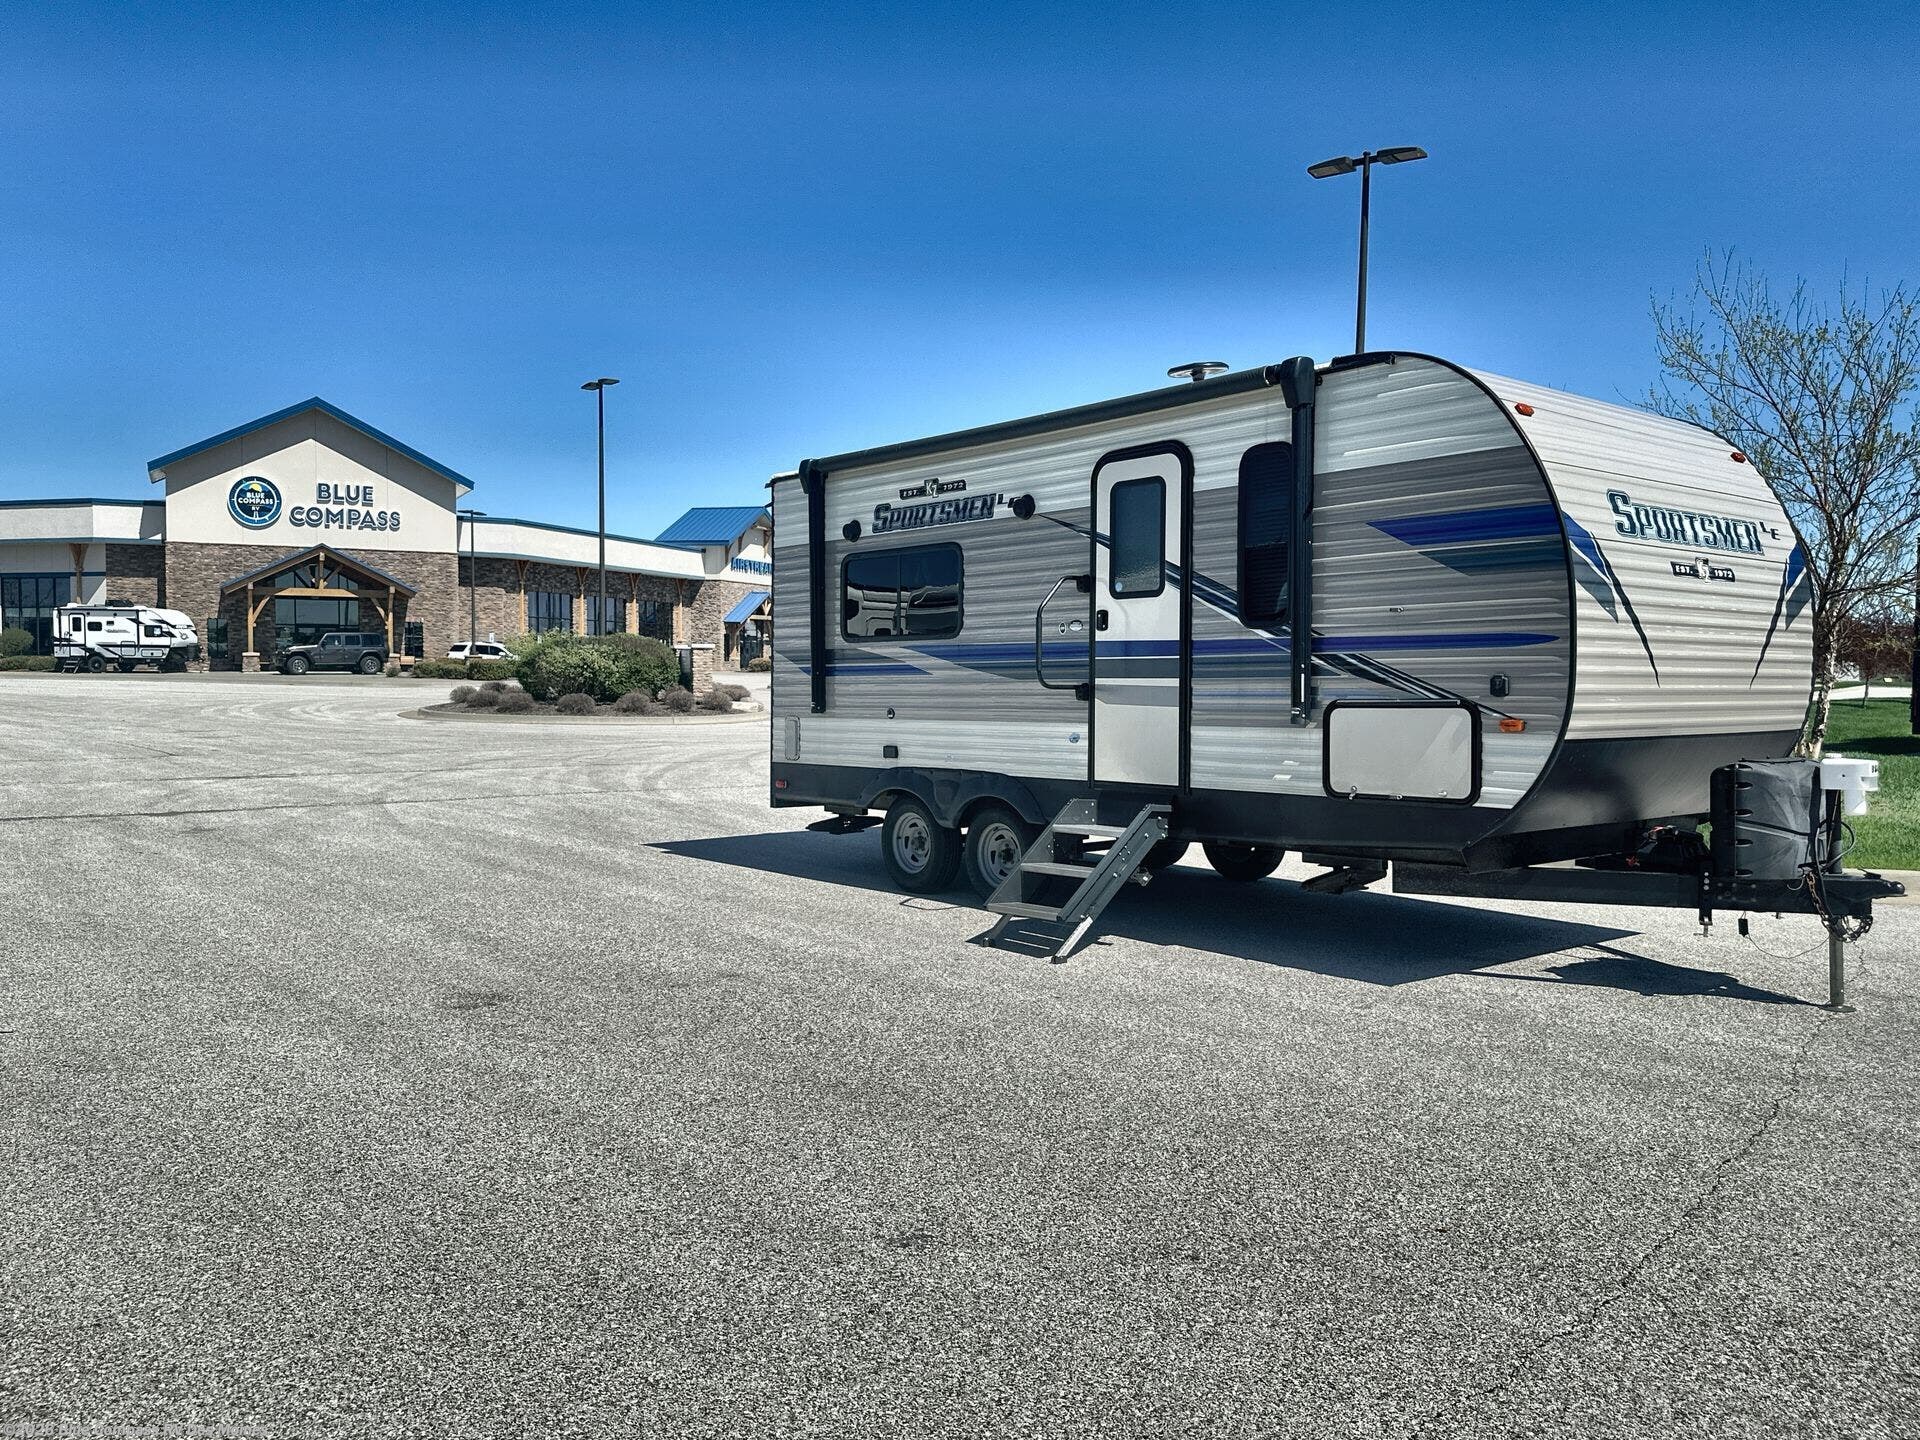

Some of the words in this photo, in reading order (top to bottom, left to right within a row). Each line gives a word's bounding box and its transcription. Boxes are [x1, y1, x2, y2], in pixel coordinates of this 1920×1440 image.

[246, 491, 265, 499] BLUE
[316, 482, 374, 507] BLUE
[943, 482, 964, 491] 1972
[237, 497, 274, 505] COMPASS
[289, 506, 401, 532] COMPASS
[872, 493, 997, 533] SPORTSMEN
[1607, 488, 1765, 555] SPORTSMEN
[1759, 521, 1780, 541] LE
[1675, 564, 1693, 574] EST.
[1714, 569, 1733, 578] 1972
